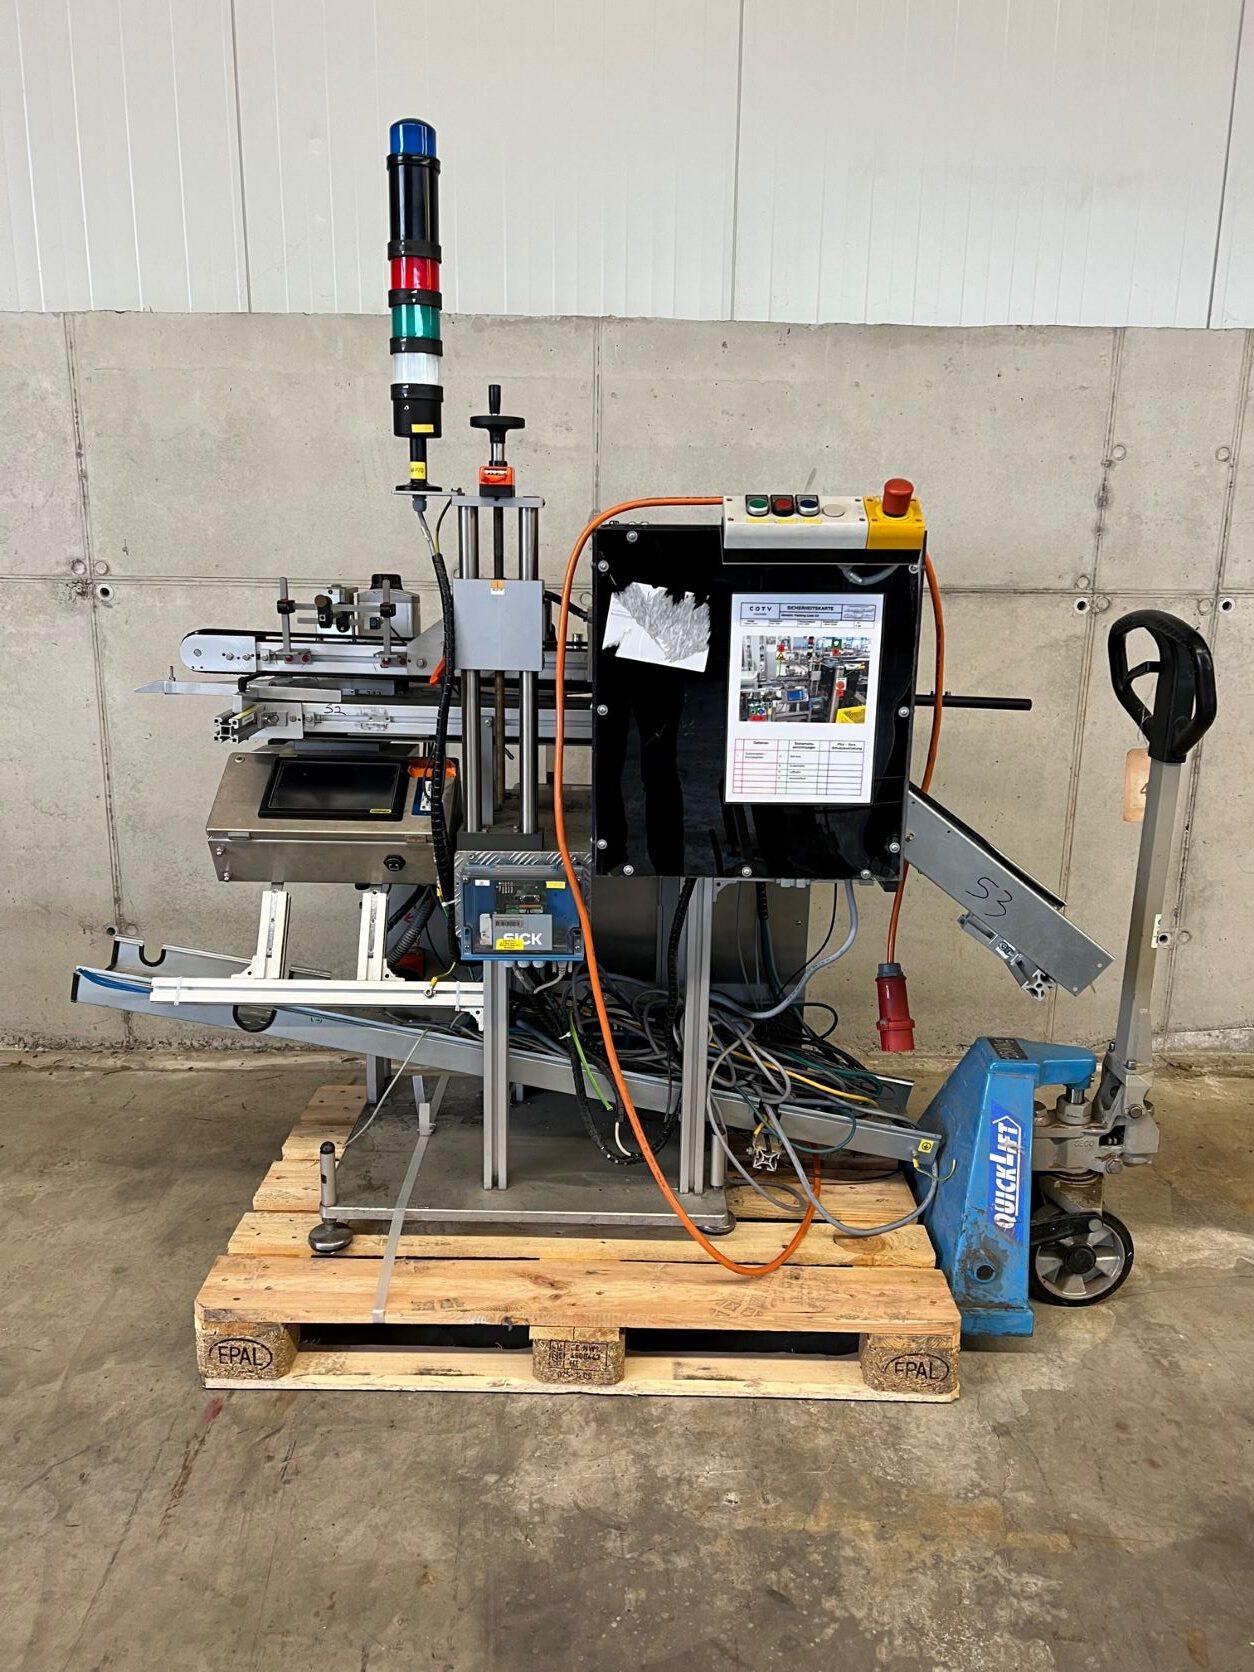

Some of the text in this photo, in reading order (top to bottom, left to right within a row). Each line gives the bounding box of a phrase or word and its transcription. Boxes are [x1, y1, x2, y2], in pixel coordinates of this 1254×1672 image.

[965, 876, 1013, 917] S3
[989, 1121, 1019, 1231] QUICKLIFT
[218, 1345, 263, 1366] EPAL
